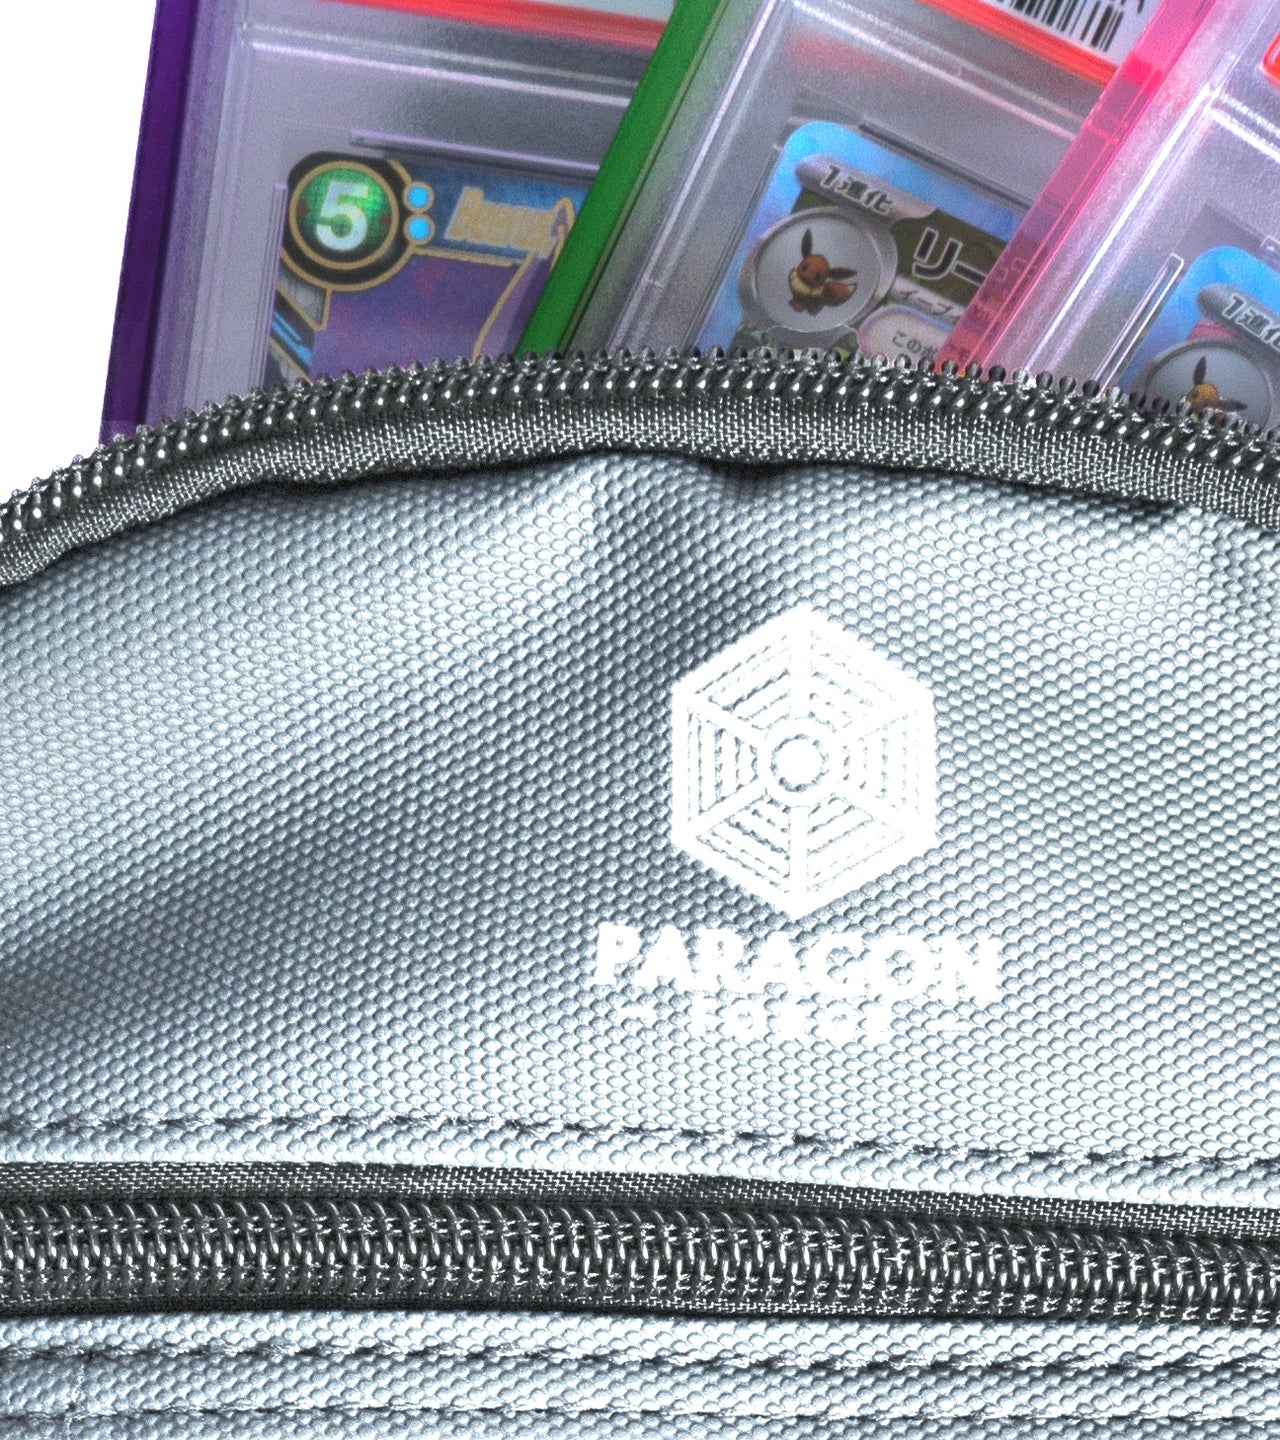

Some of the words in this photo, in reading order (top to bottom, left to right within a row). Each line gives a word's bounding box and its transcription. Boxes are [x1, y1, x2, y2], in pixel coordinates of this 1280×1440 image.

[315, 179, 369, 252] 5
[820, 163, 897, 216] 1進化
[594, 921, 1001, 1003] PARAGON
